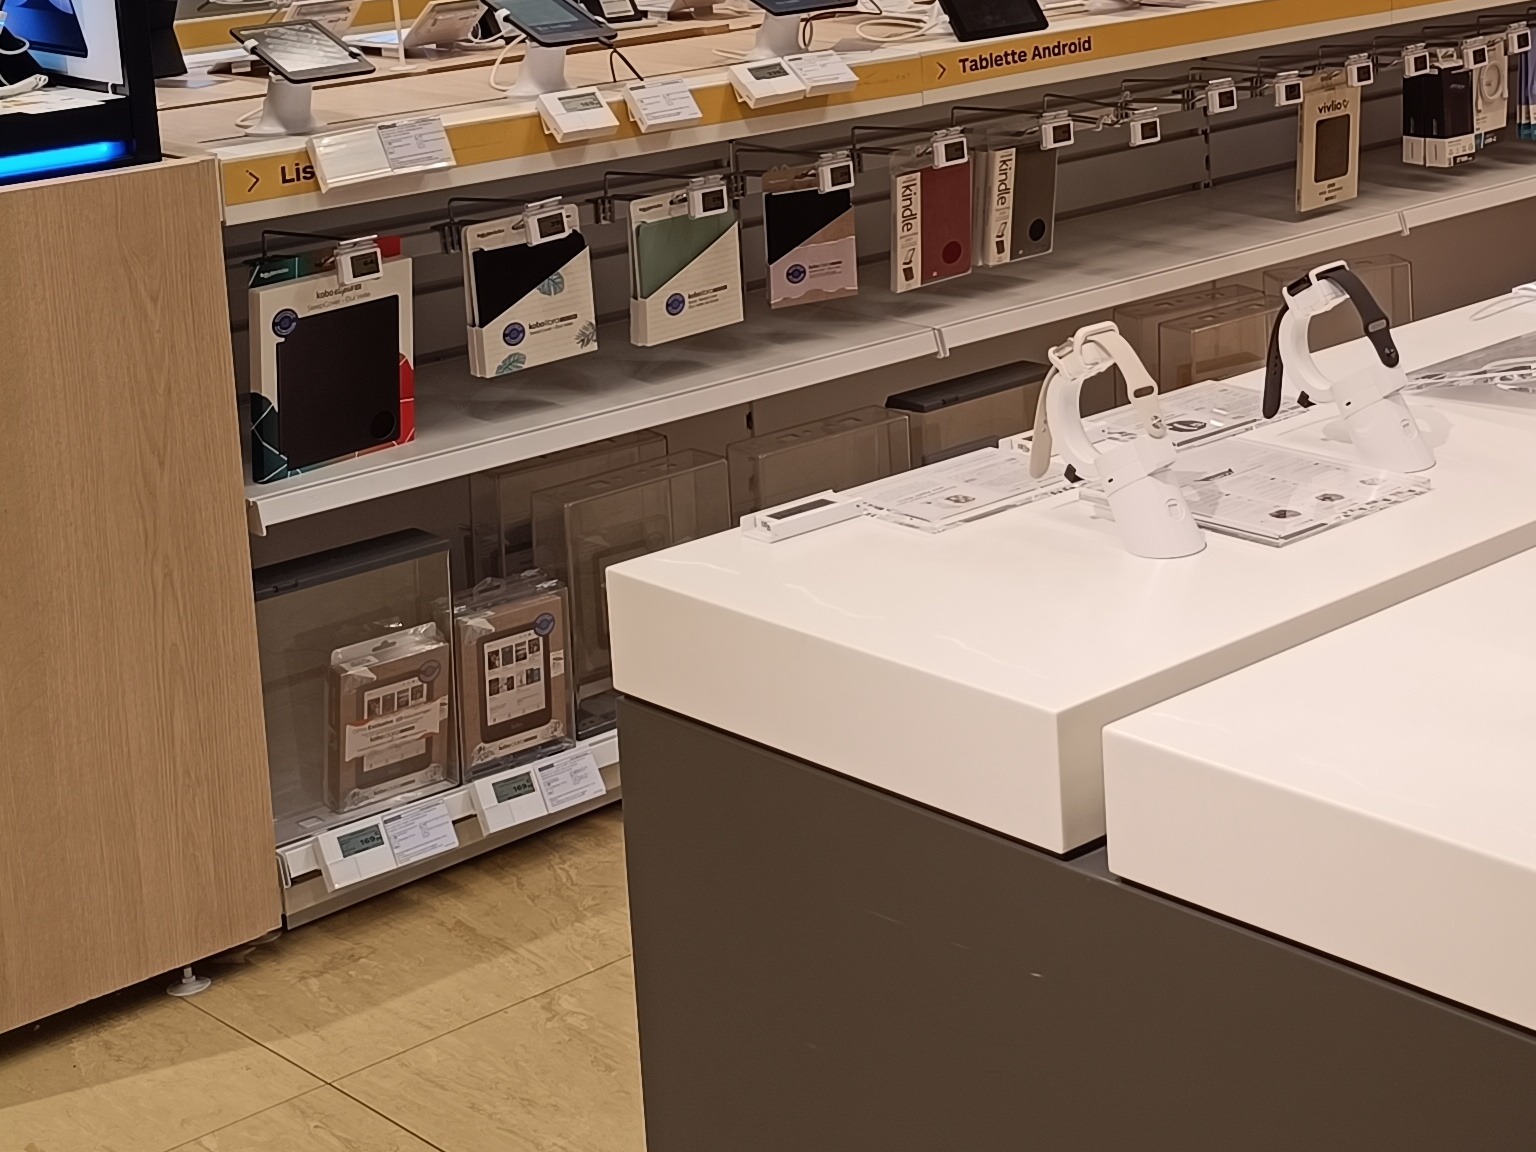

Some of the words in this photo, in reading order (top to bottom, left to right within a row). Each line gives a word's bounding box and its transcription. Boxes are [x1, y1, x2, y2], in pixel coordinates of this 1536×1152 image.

[959, 49, 1027, 73] Tablette
[1031, 35, 1092, 61] Android
[1318, 101, 1341, 114] vivlio
[281, 162, 315, 184] Lis
[997, 157, 1013, 206] kindle
[901, 182, 917, 233] kindle
